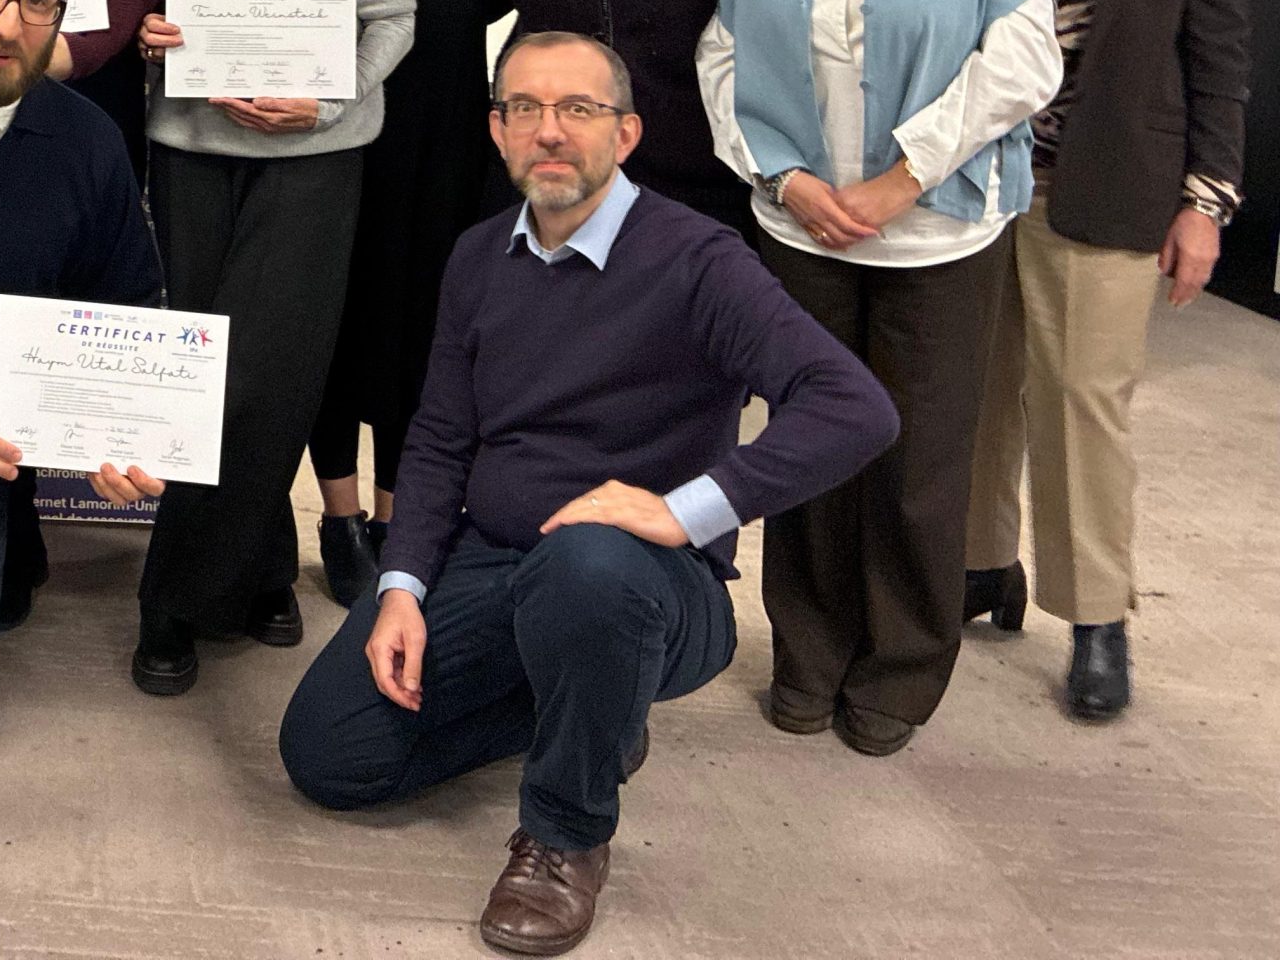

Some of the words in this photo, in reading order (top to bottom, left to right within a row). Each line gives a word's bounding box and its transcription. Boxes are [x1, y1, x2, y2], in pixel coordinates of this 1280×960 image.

[191, 4, 246, 18] Tamara
[57, 323, 167, 344] CERTIFICAT
[77, 353, 128, 372] Vital
